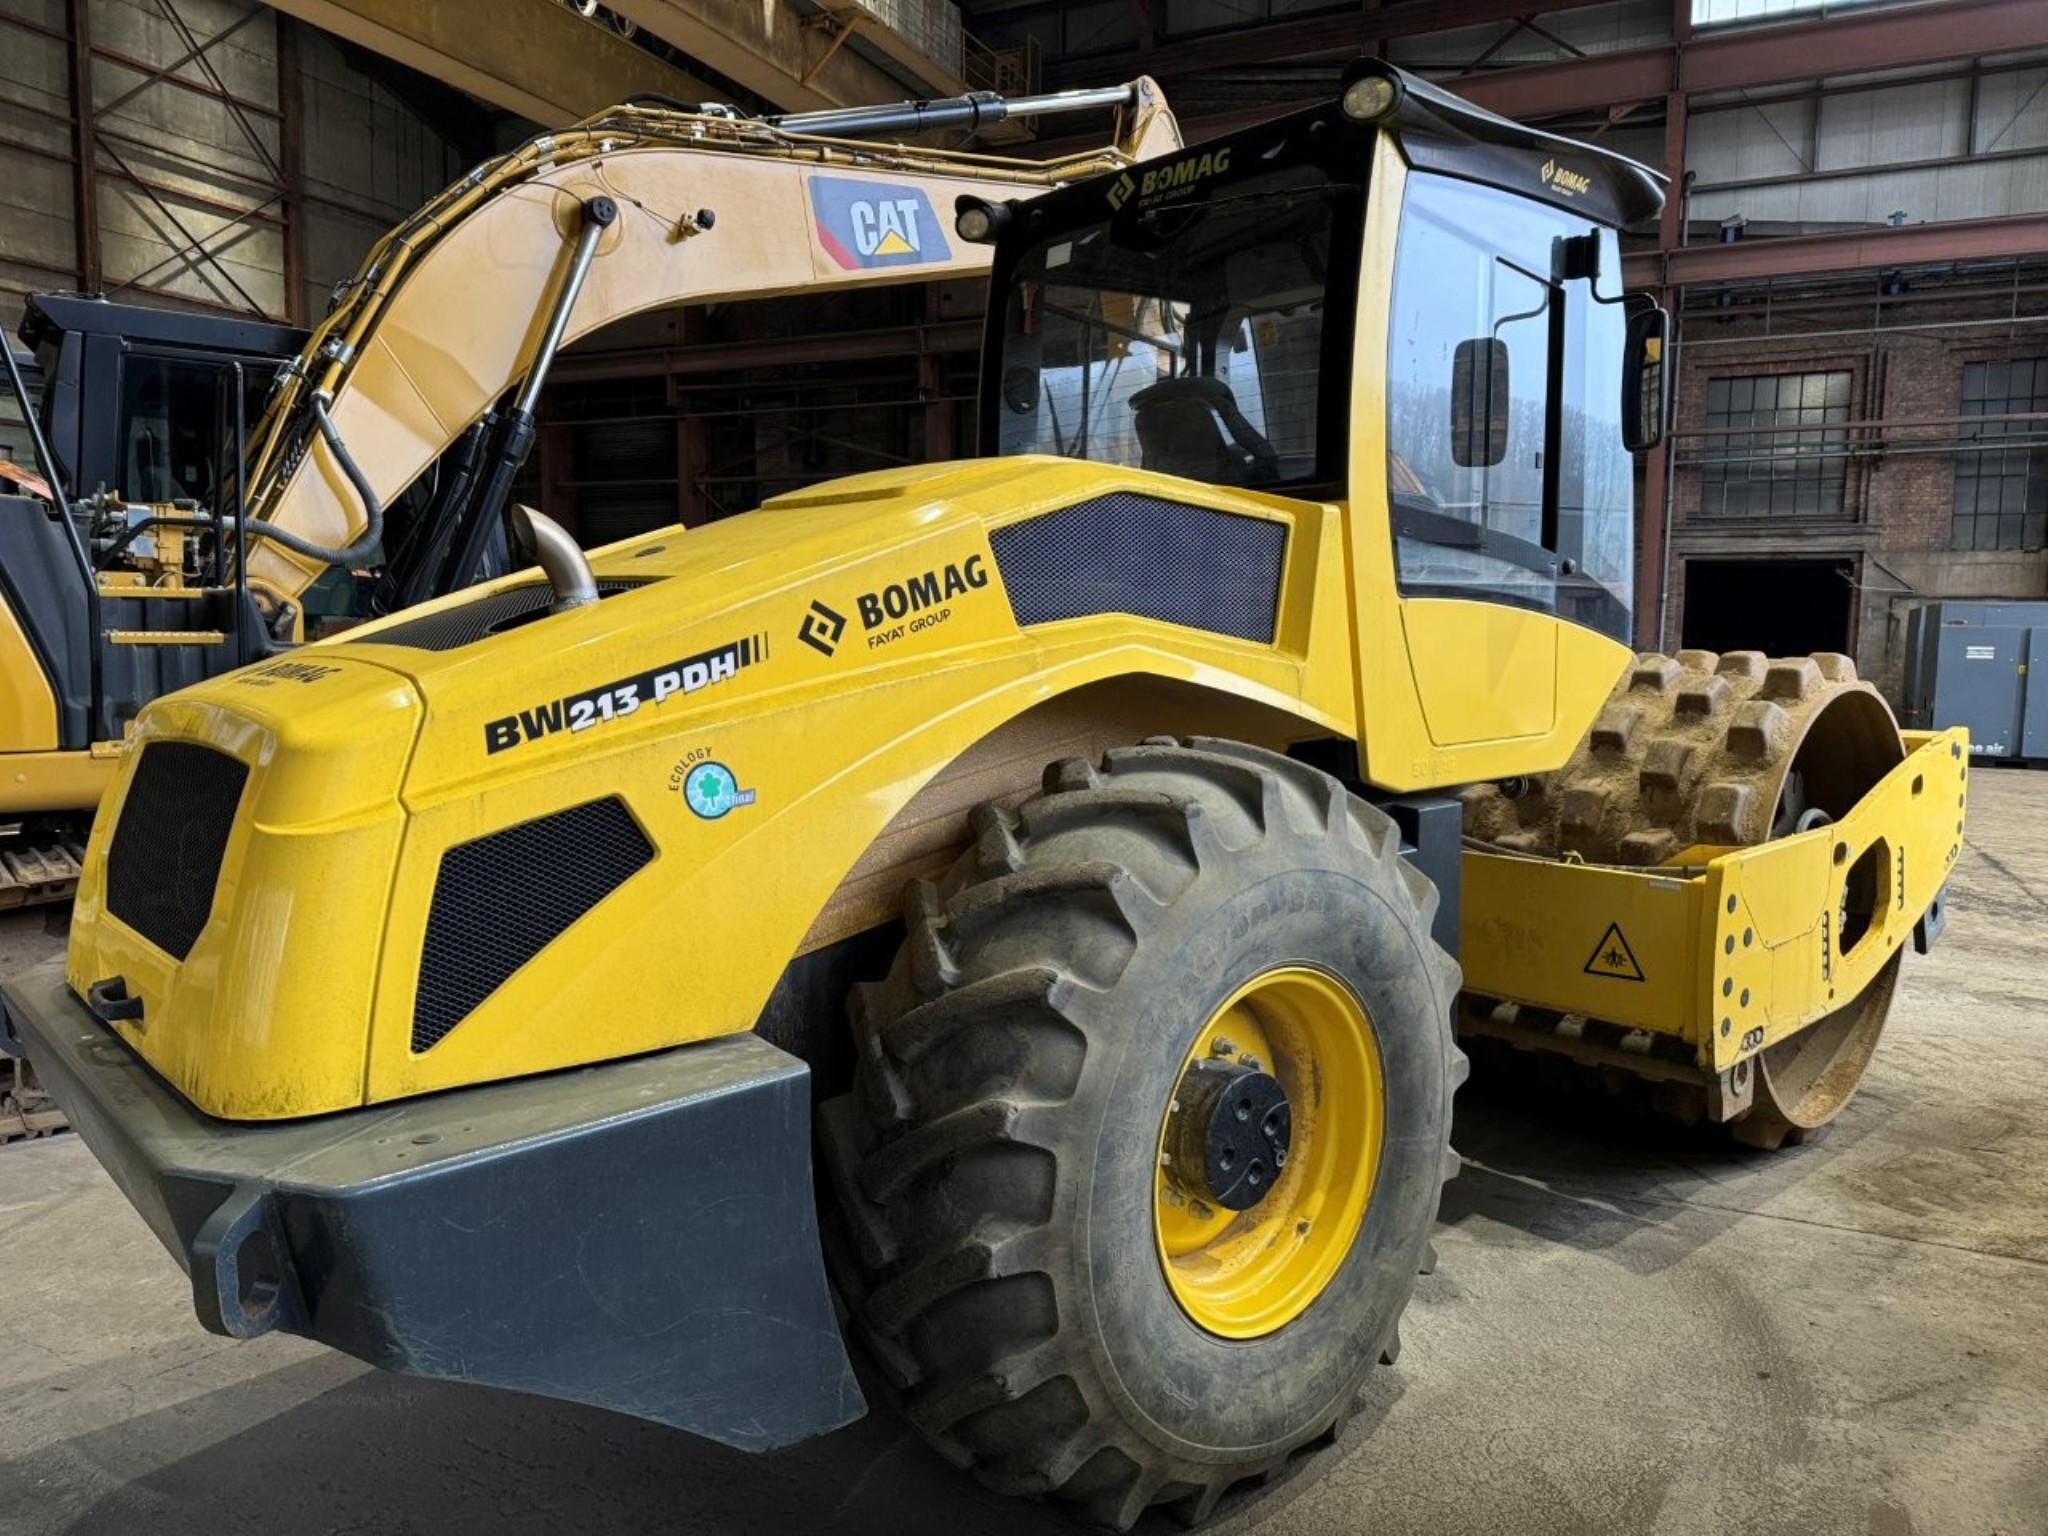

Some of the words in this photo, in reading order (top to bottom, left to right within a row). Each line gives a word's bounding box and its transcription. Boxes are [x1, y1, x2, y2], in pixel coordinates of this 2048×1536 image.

[1141, 148, 1231, 196] BOMAG
[850, 199, 921, 257] CAT
[857, 554, 988, 631] BOMAG
[867, 626, 906, 650] FAYAT
[909, 608, 951, 634] GROUP
[653, 652, 737, 704] PDH
[668, 746, 713, 792] ECOLOGY
